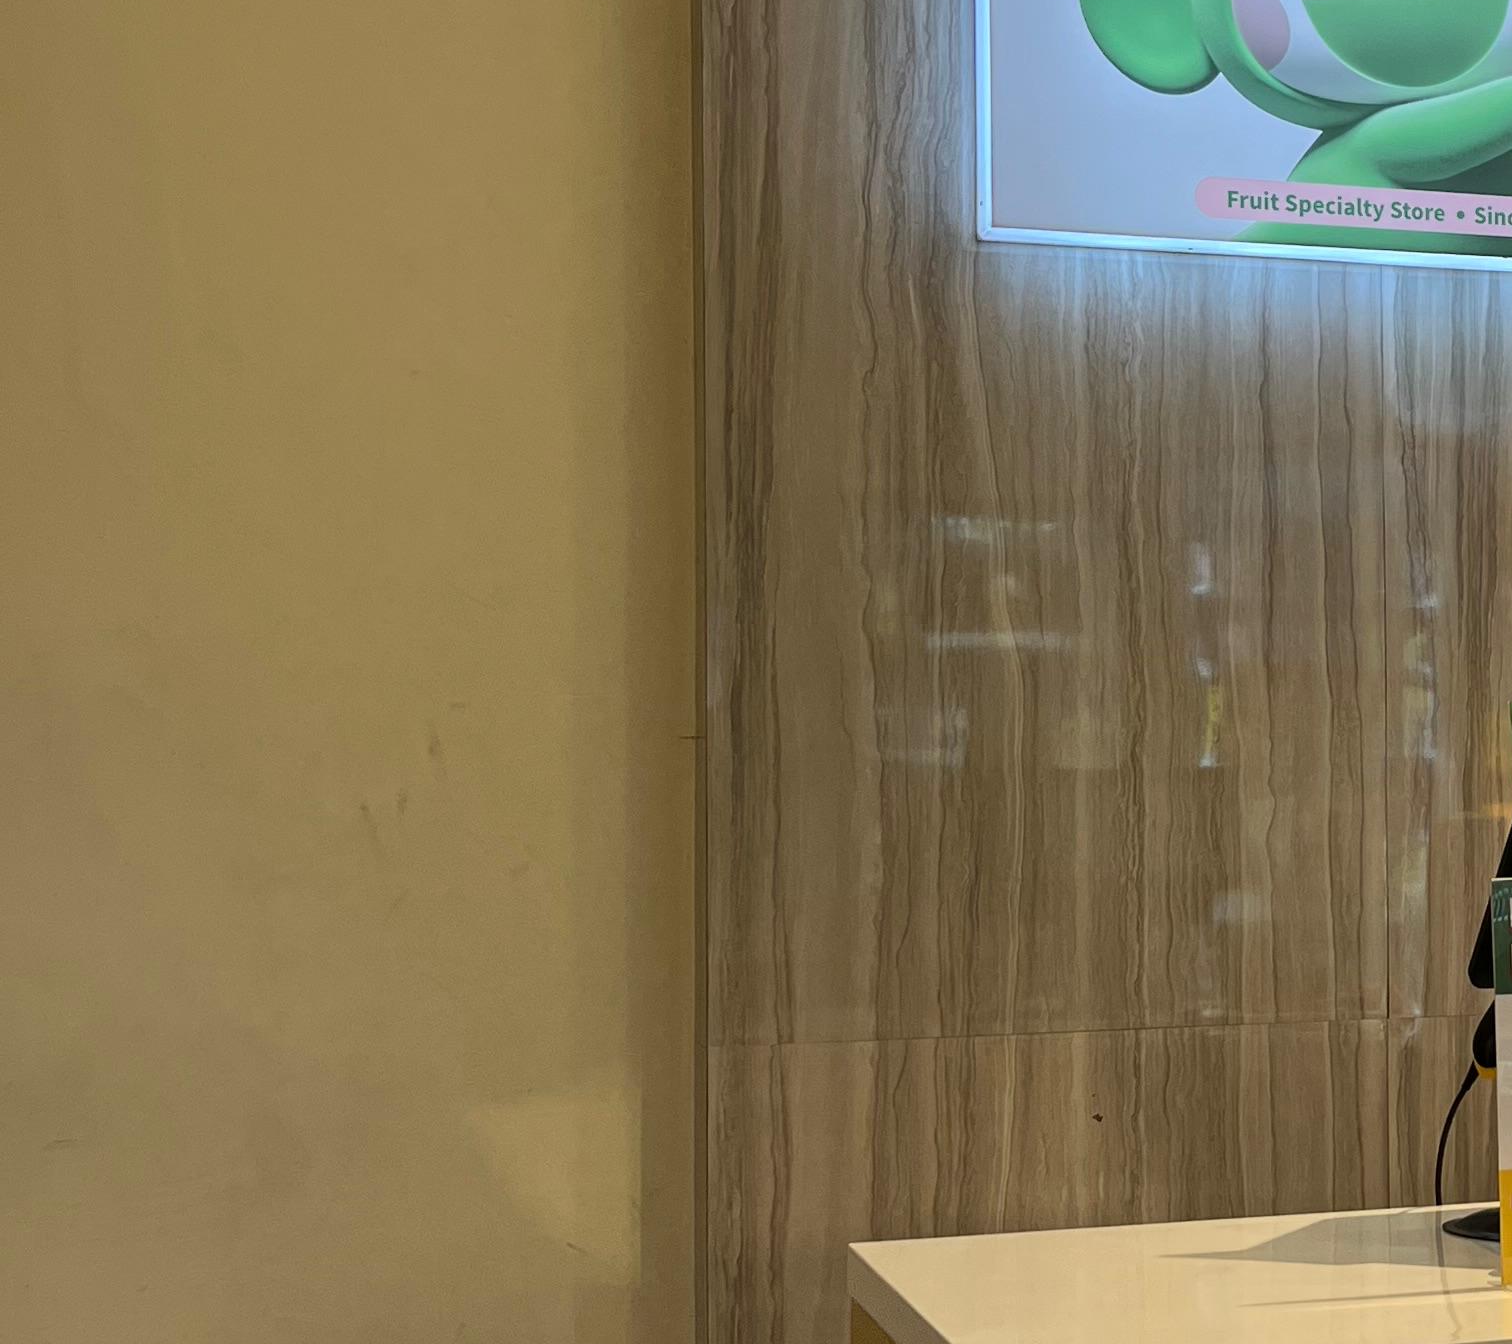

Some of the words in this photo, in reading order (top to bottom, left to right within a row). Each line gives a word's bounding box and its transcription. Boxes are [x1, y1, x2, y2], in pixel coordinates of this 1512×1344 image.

[1227, 190, 1279, 212] Fruit
[1285, 194, 1385, 222] Specialty
[1390, 201, 1446, 223] Store
